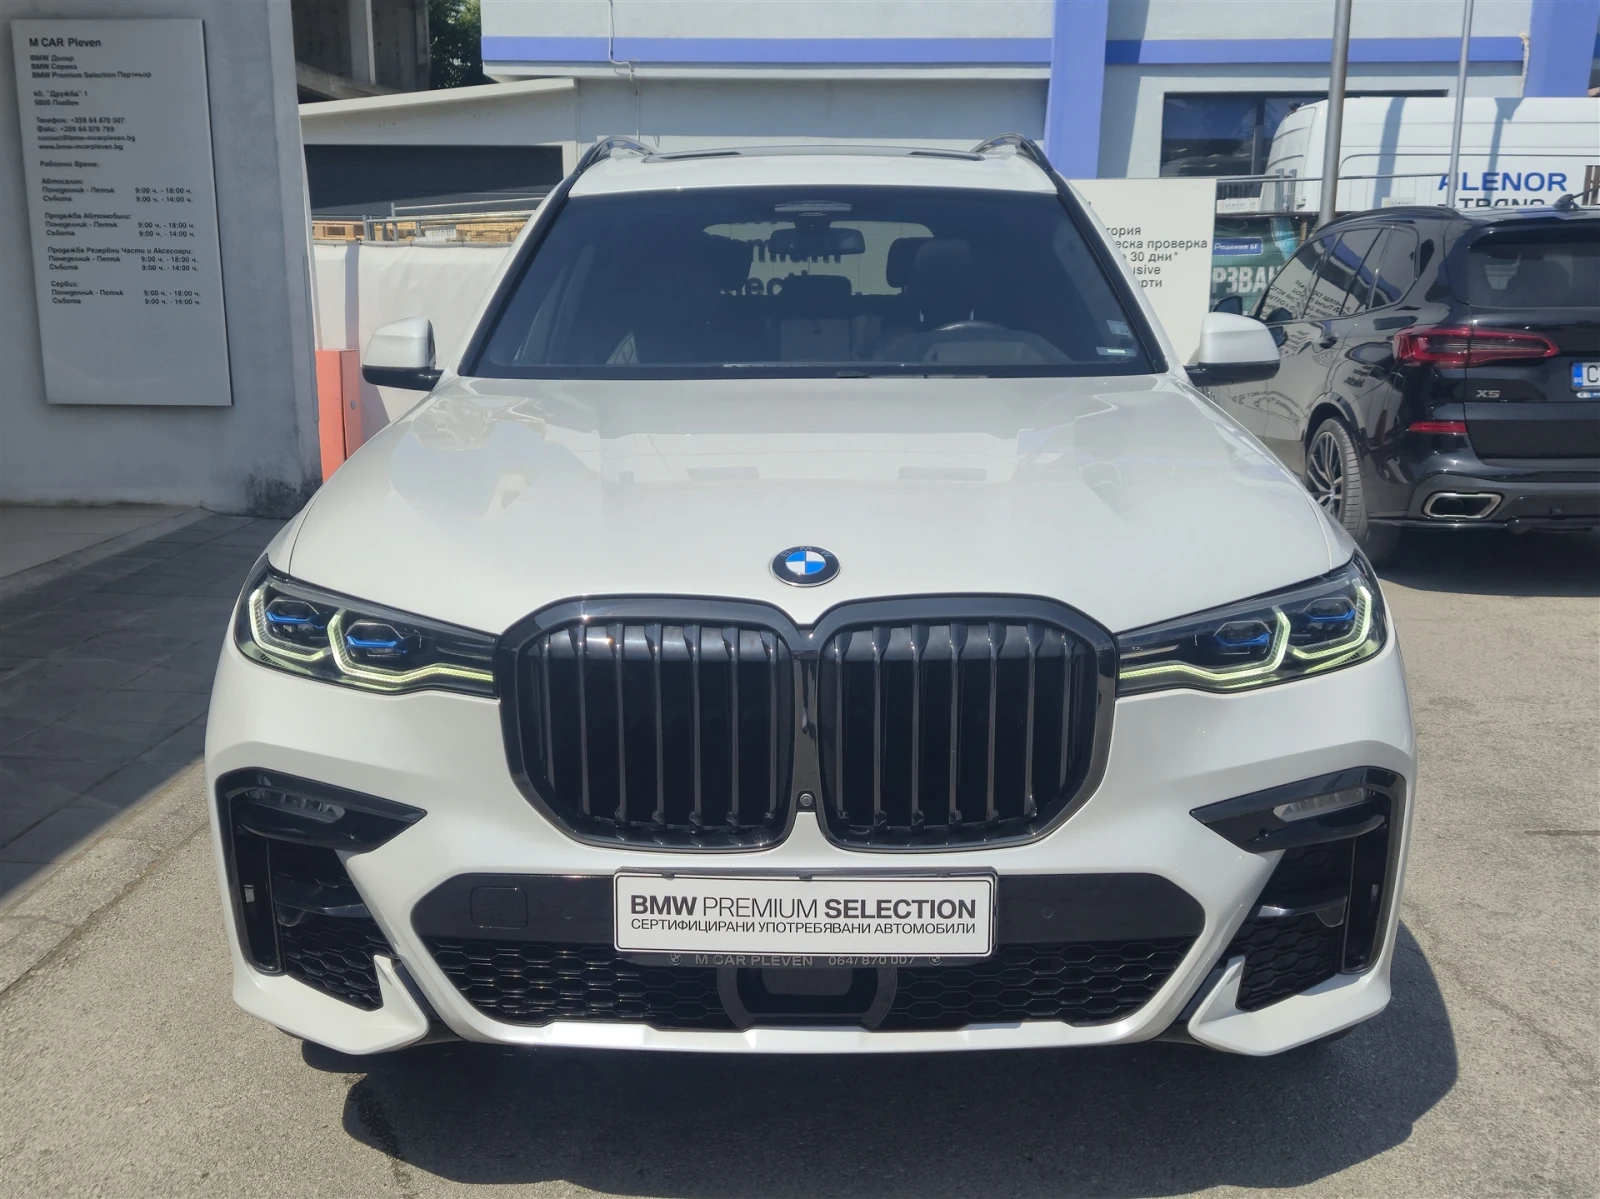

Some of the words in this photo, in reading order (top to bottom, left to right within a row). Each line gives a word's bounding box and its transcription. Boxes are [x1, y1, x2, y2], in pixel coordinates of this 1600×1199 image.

[29, 38, 38, 46] M
[41, 38, 64, 47] CAR
[68, 38, 102, 47] Pleven
[30, 54, 49, 62] BMW
[44, 212, 82, 220] Продажба
[1147, 240, 1208, 251] проверка
[1130, 252, 1144, 262] 30
[51, 280, 78, 288] Сервиз:
[1138, 279, 1162, 288] рти
[1476, 390, 1500, 398] X5
[631, 894, 698, 916] BMW
[702, 896, 818, 919] PREMIUM
[824, 898, 976, 920] SELECTION
[631, 918, 755, 934] СЕРТИФИЦИРАНИ
[758, 920, 871, 934] УПОТРЕБЯВАНИ
[874, 922, 976, 934] АВТОМОБИЛИ
[696, 955, 709, 965] M
[712, 956, 746, 966] CAR
[750, 956, 813, 967] PLEVEN
[862, 956, 886, 966] 870
[890, 956, 914, 966] 007
